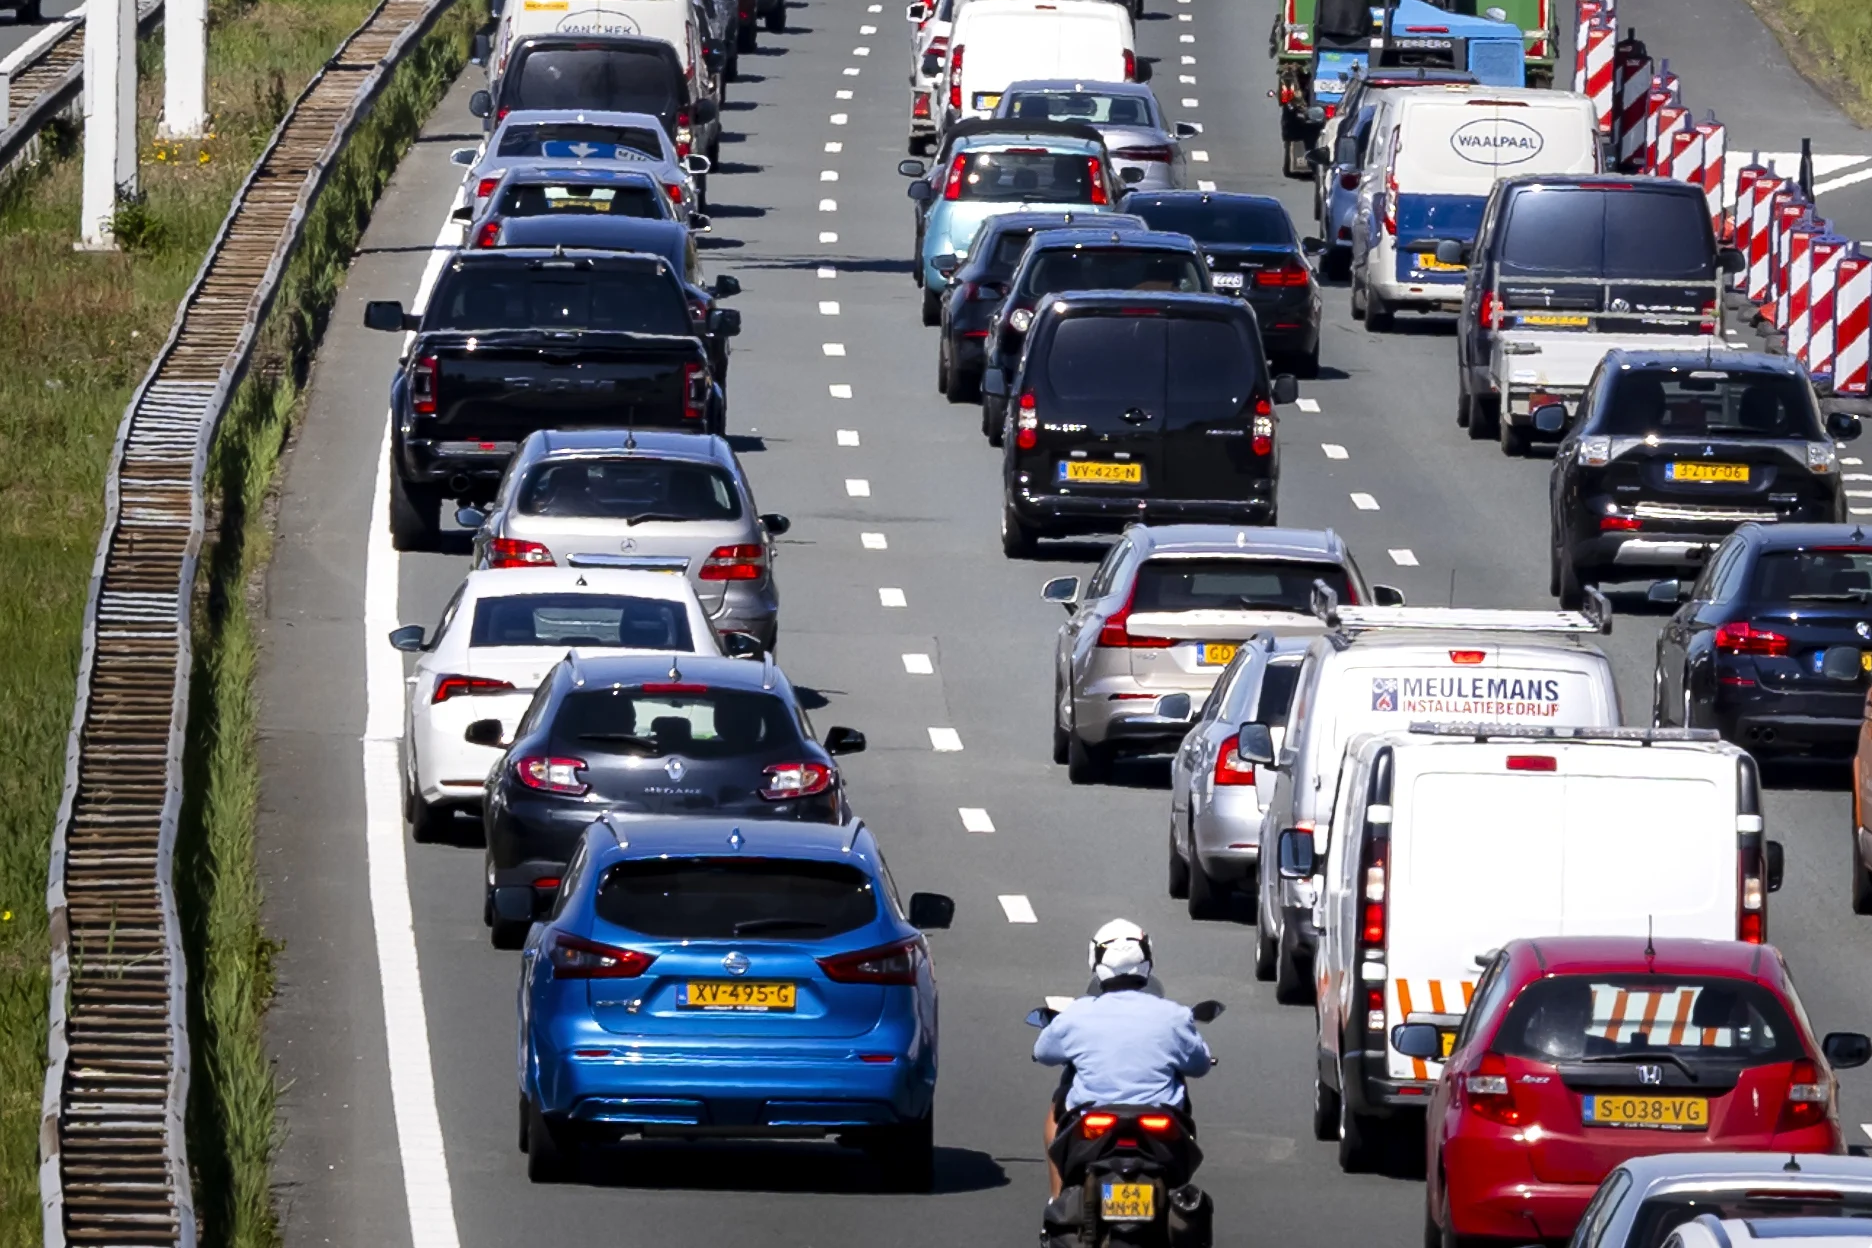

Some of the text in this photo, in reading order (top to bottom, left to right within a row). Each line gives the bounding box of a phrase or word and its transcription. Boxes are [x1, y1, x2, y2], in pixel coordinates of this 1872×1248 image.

[1394, 39, 1453, 49] TERBERG
[1457, 134, 1538, 150] WAALPAAL
[1402, 676, 1561, 702] MEULEMANS
[1402, 698, 1561, 718] INSTALLATIEBEDRIJF
[694, 983, 790, 1003] XV-495-G
[1600, 1099, 1701, 1122] S-038-VG
[1121, 1185, 1142, 1200] 64
